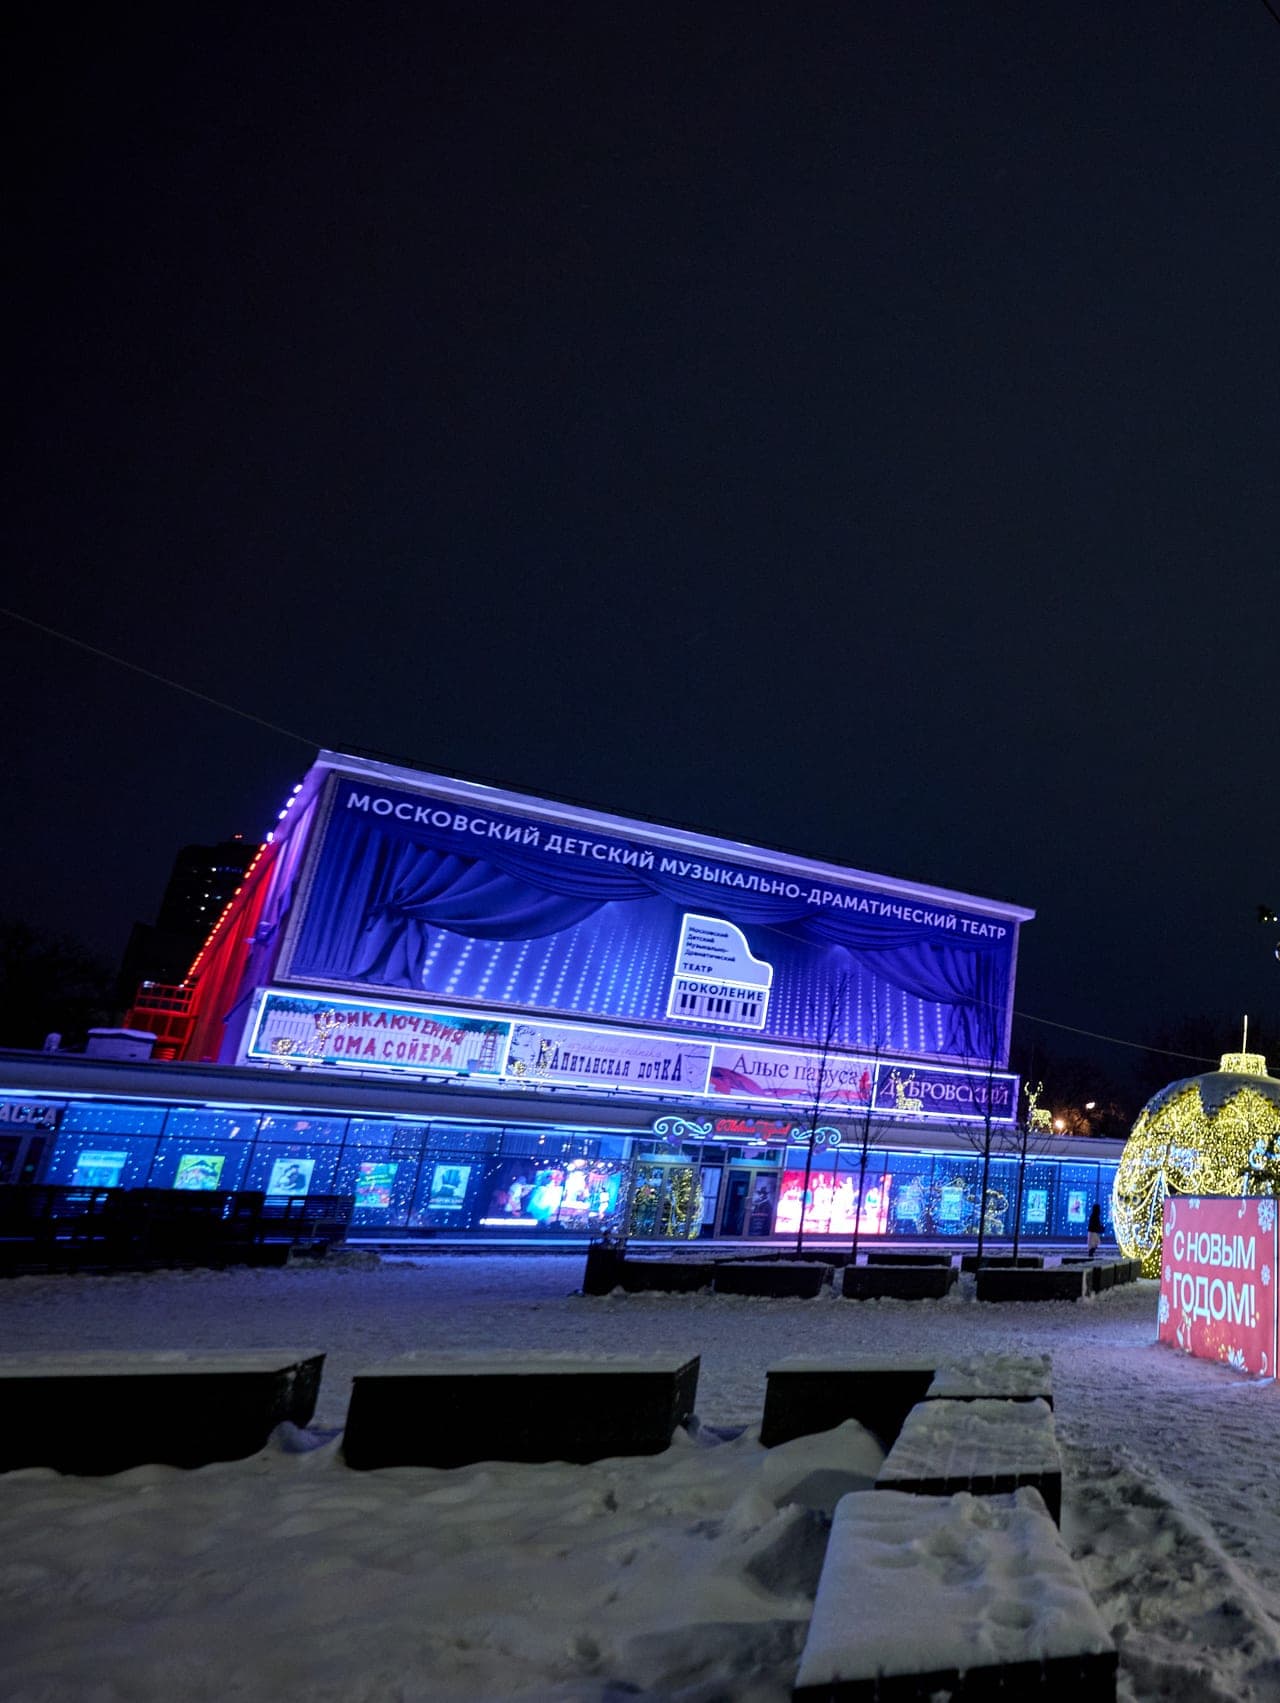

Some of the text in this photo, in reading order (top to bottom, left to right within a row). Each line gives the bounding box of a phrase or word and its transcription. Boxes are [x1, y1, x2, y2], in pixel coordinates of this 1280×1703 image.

[347, 792, 1007, 940] МОСКОВСКИЙ ДЕТСКИЙ МУЗЫКАЛЬНО-ДРАМАТИЧЕСКИЙ ТЕАТР
[682, 962, 713, 973] ТЕАТР
[678, 980, 764, 1002] ПОКОЛЕНИЕ
[382, 1037, 454, 1064] СОЙЕРА
[732, 1053, 860, 1091] Алые паруса
[879, 1077, 1009, 1105] ДБРОВСКИЙ
[1172, 1229, 1256, 1271] С НОВЫМ
[1172, 1271, 1257, 1329] ГОДОМ!
